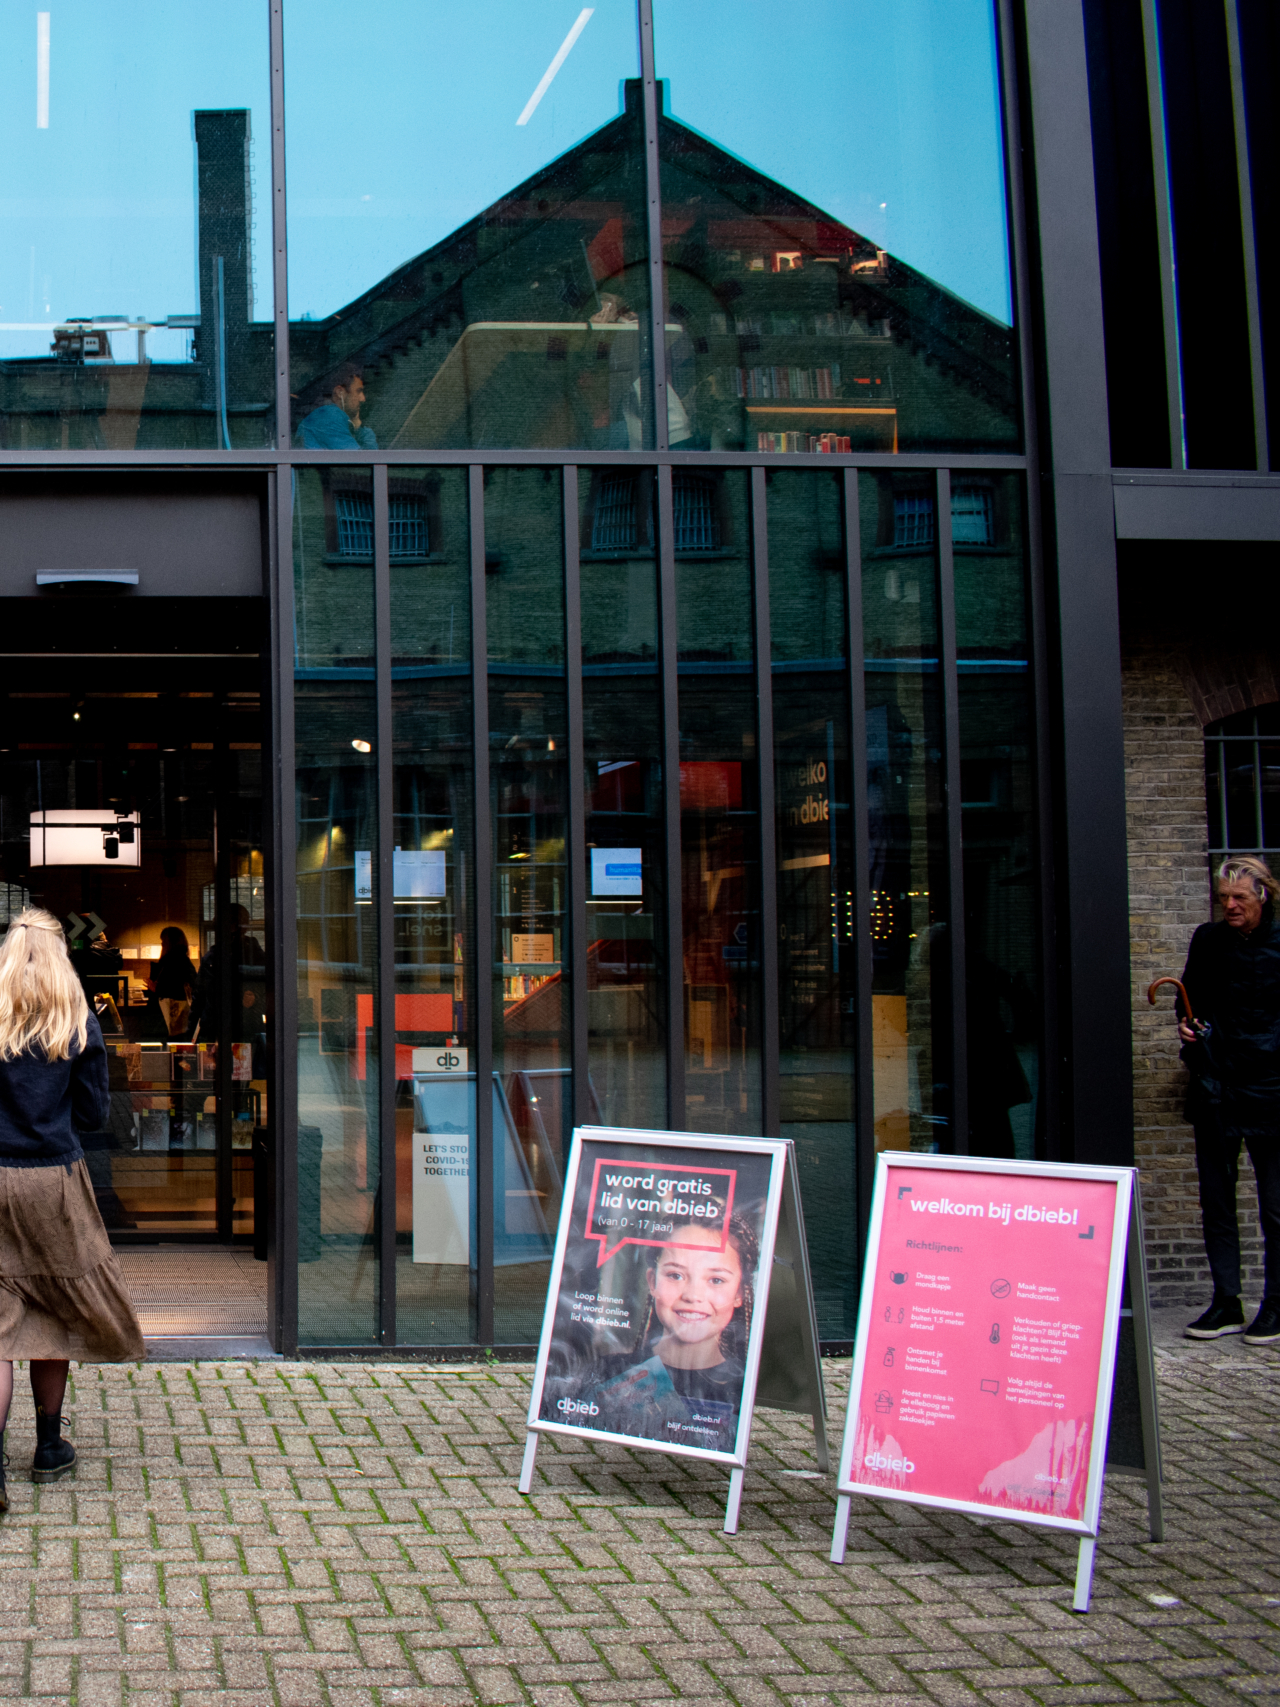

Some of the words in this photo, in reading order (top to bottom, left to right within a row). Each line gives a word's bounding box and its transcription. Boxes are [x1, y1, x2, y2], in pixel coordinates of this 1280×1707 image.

[437, 1052, 460, 1070] db
[423, 1144, 447, 1153] LET'S
[605, 1174, 654, 1190] word
[656, 1178, 712, 1197] gratis
[600, 1191, 623, 1209] lid
[626, 1197, 660, 1212] van
[663, 1198, 718, 1218] dbieb
[910, 1198, 984, 1217] welkom
[988, 1202, 1011, 1226] bij
[1014, 1205, 1079, 1225] dbieb!
[597, 1215, 618, 1226] (van
[620, 1217, 628, 1227] 0
[638, 1219, 650, 1229] 17
[651, 1222, 674, 1233] jaar)
[906, 1239, 963, 1253] Richtlijnen:
[916, 1272, 936, 1281] Draag
[915, 1281, 951, 1291] mondkapje
[1017, 1282, 1037, 1290] Maak
[575, 1290, 596, 1303] Loop
[596, 1293, 624, 1305] binnen
[1016, 1291, 1060, 1302] handcontact
[572, 1302, 582, 1310] of
[583, 1305, 604, 1314] word
[605, 1307, 630, 1317] online
[912, 1305, 930, 1314] Houd
[931, 1307, 954, 1316] binnen
[570, 1312, 581, 1321] lid
[582, 1315, 594, 1324] via
[595, 1317, 631, 1329] dbieb.nl.
[911, 1313, 932, 1322] buiten
[1014, 1316, 1051, 1327] Verkouden
[1061, 1323, 1083, 1332] griep-
[910, 1322, 935, 1331] afstand
[1012, 1325, 1046, 1335] klachten?
[1047, 1329, 1061, 1338] Blijf
[1062, 1331, 1080, 1339] thuis
[1012, 1334, 1028, 1342] (ook
[1040, 1337, 1066, 1346] iemand
[907, 1346, 935, 1357] Ontsmet
[936, 1351, 944, 1359] je
[1021, 1343, 1029, 1352] je
[1050, 1347, 1068, 1355] deze
[906, 1355, 930, 1364] handen
[931, 1358, 940, 1367] bij
[1010, 1351, 1040, 1361] klachten
[1040, 1354, 1062, 1364] heeft)
[905, 1363, 947, 1376] binnenkomst
[1007, 1377, 1023, 1387] Volg
[1024, 1379, 1043, 1389] altijd
[1043, 1381, 1053, 1389] de
[902, 1388, 921, 1398] Hoest
[932, 1394, 946, 1402] nies
[1006, 1386, 1051, 1398] aanwijzingen
[556, 1397, 600, 1416] dbieb
[910, 1399, 940, 1411] elleboog
[1005, 1394, 1017, 1402] het
[1018, 1397, 1054, 1407] personeel
[1054, 1402, 1065, 1410] op
[692, 1413, 721, 1424] dbieb.nl
[899, 1406, 925, 1415] gebruik
[925, 1410, 955, 1420] papieren
[667, 1421, 681, 1432] blijf
[899, 1415, 935, 1427] zakdoekjes
[864, 1452, 916, 1473] dbieb
